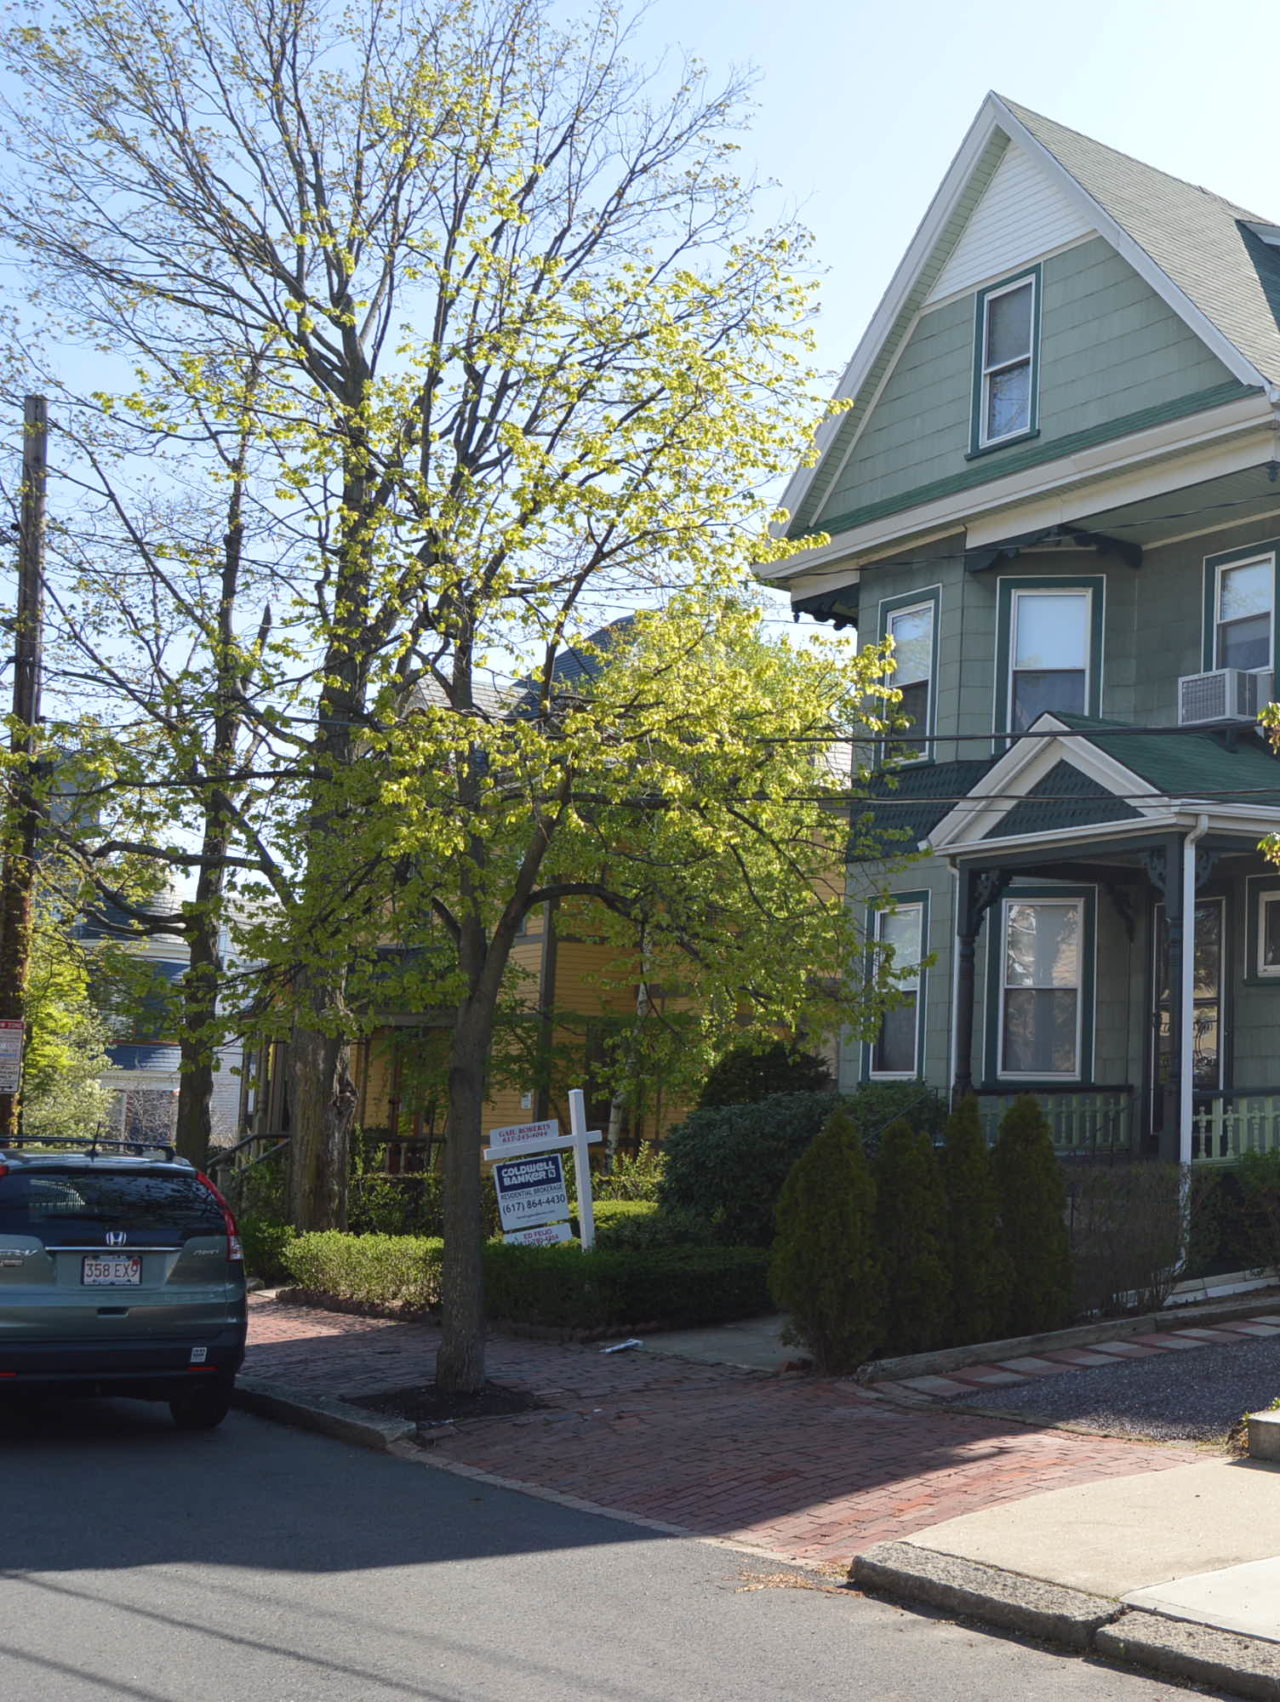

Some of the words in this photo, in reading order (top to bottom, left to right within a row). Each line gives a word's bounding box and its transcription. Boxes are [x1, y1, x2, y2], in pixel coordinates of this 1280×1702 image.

[501, 1160, 556, 1177] COLDWELL
[503, 1171, 547, 1186] BANKER
[500, 1190, 533, 1201] RESIDENTIAL
[533, 1183, 563, 1195] BROKERAGE
[502, 1201, 525, 1216] (617)
[526, 1194, 566, 1210] 864-4430
[86, 1263, 111, 1278] 358
[114, 1262, 139, 1278] EX9
